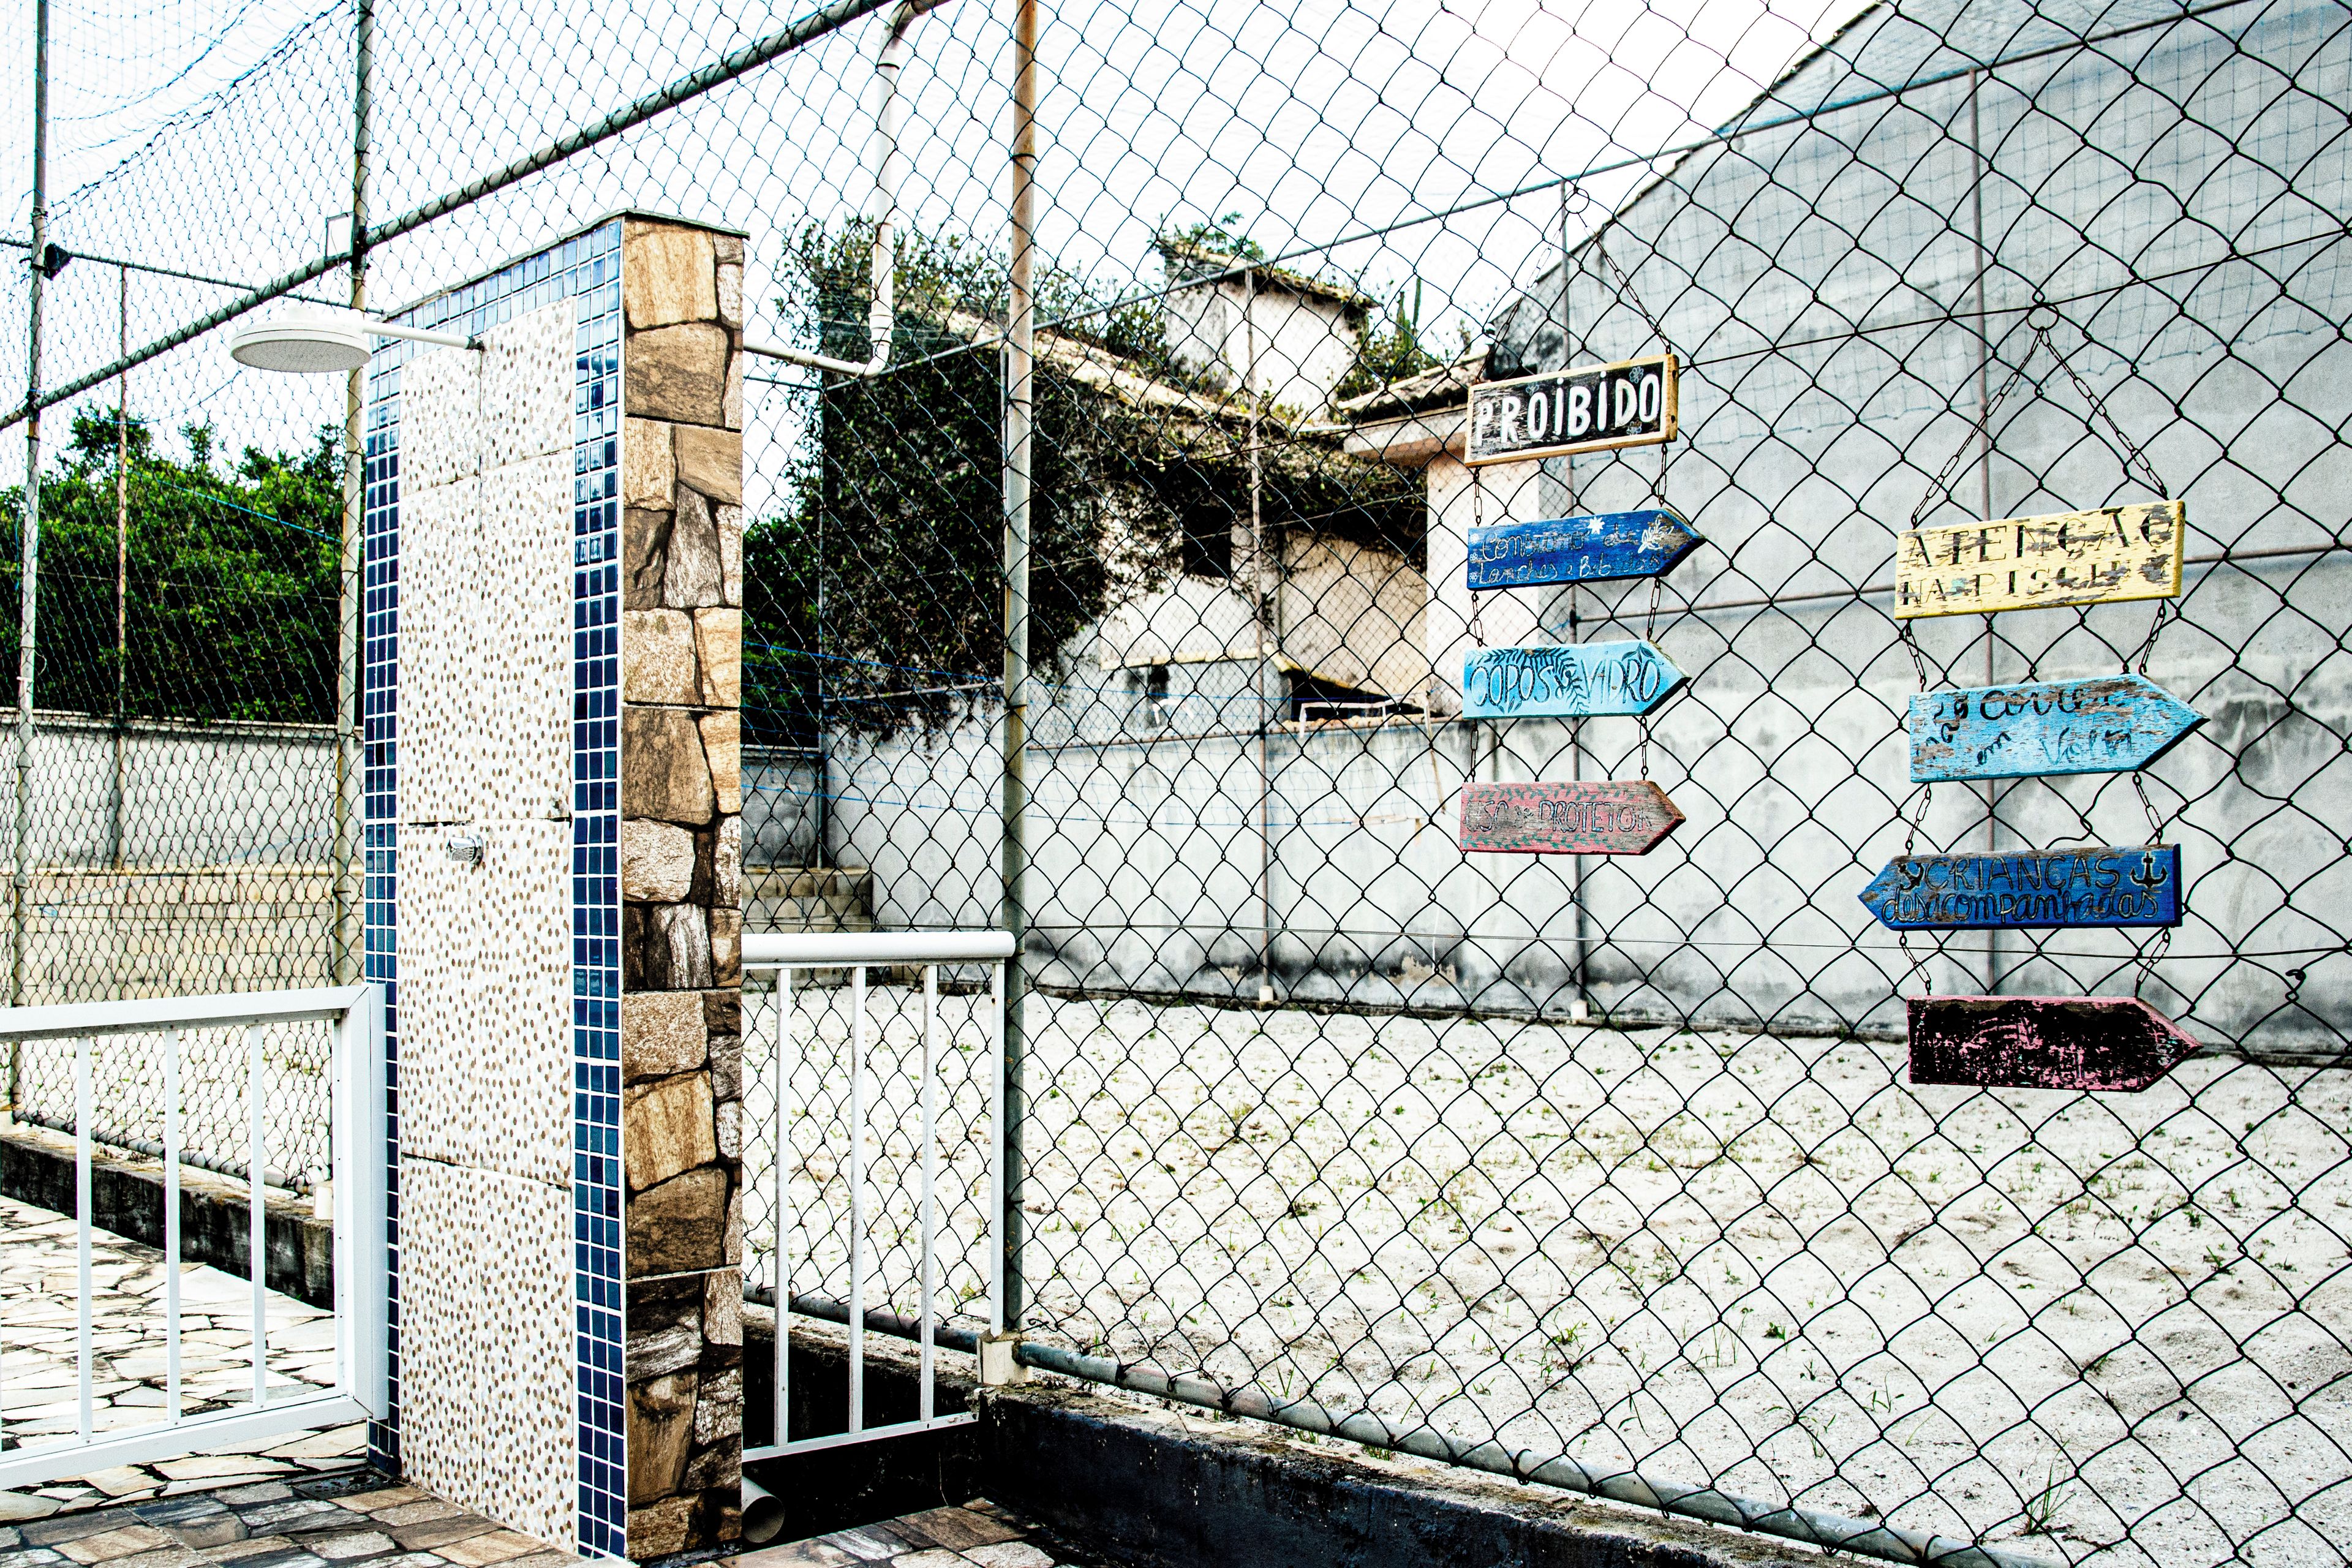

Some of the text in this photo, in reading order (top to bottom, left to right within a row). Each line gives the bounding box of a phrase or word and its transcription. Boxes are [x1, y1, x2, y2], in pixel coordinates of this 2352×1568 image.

[1476, 371, 1660, 447] PROIBIDO
[1478, 560, 1558, 584] Lanches
[1974, 556, 2169, 596] PISCI
[1471, 665, 1552, 706] COPOS
[1581, 652, 1660, 704] VIDRO
[1539, 800, 1652, 832] PROTETOR
[1925, 856, 2120, 895] CRIANÇAS
